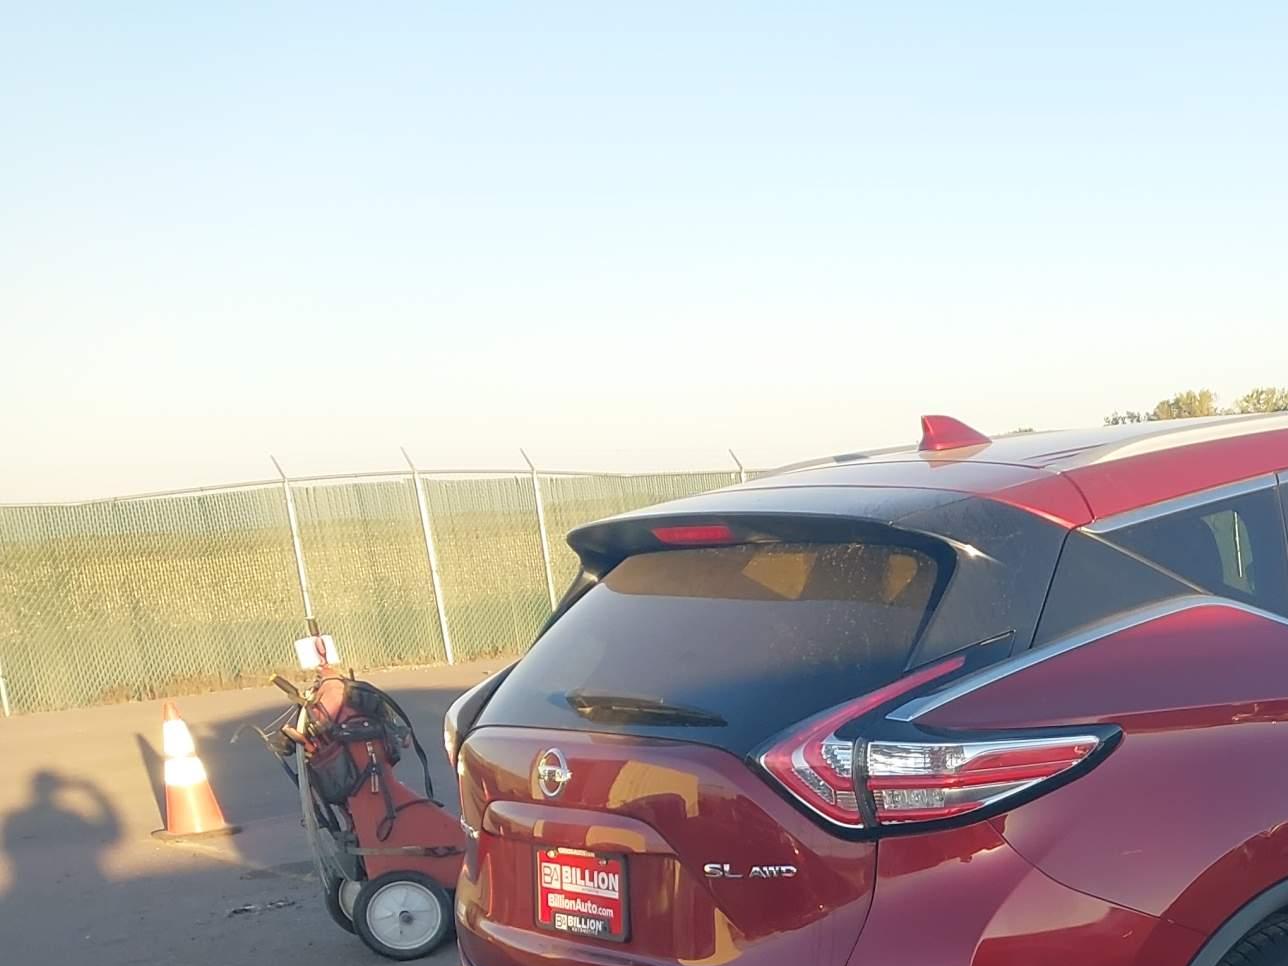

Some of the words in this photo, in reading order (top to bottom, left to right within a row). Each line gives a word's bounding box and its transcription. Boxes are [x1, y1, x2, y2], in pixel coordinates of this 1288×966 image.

[562, 865, 619, 891] BILLION
[704, 863, 743, 878] SL
[749, 865, 797, 879] AWD
[547, 893, 614, 918] BillionAuto.com
[567, 915, 602, 931] BILLION
